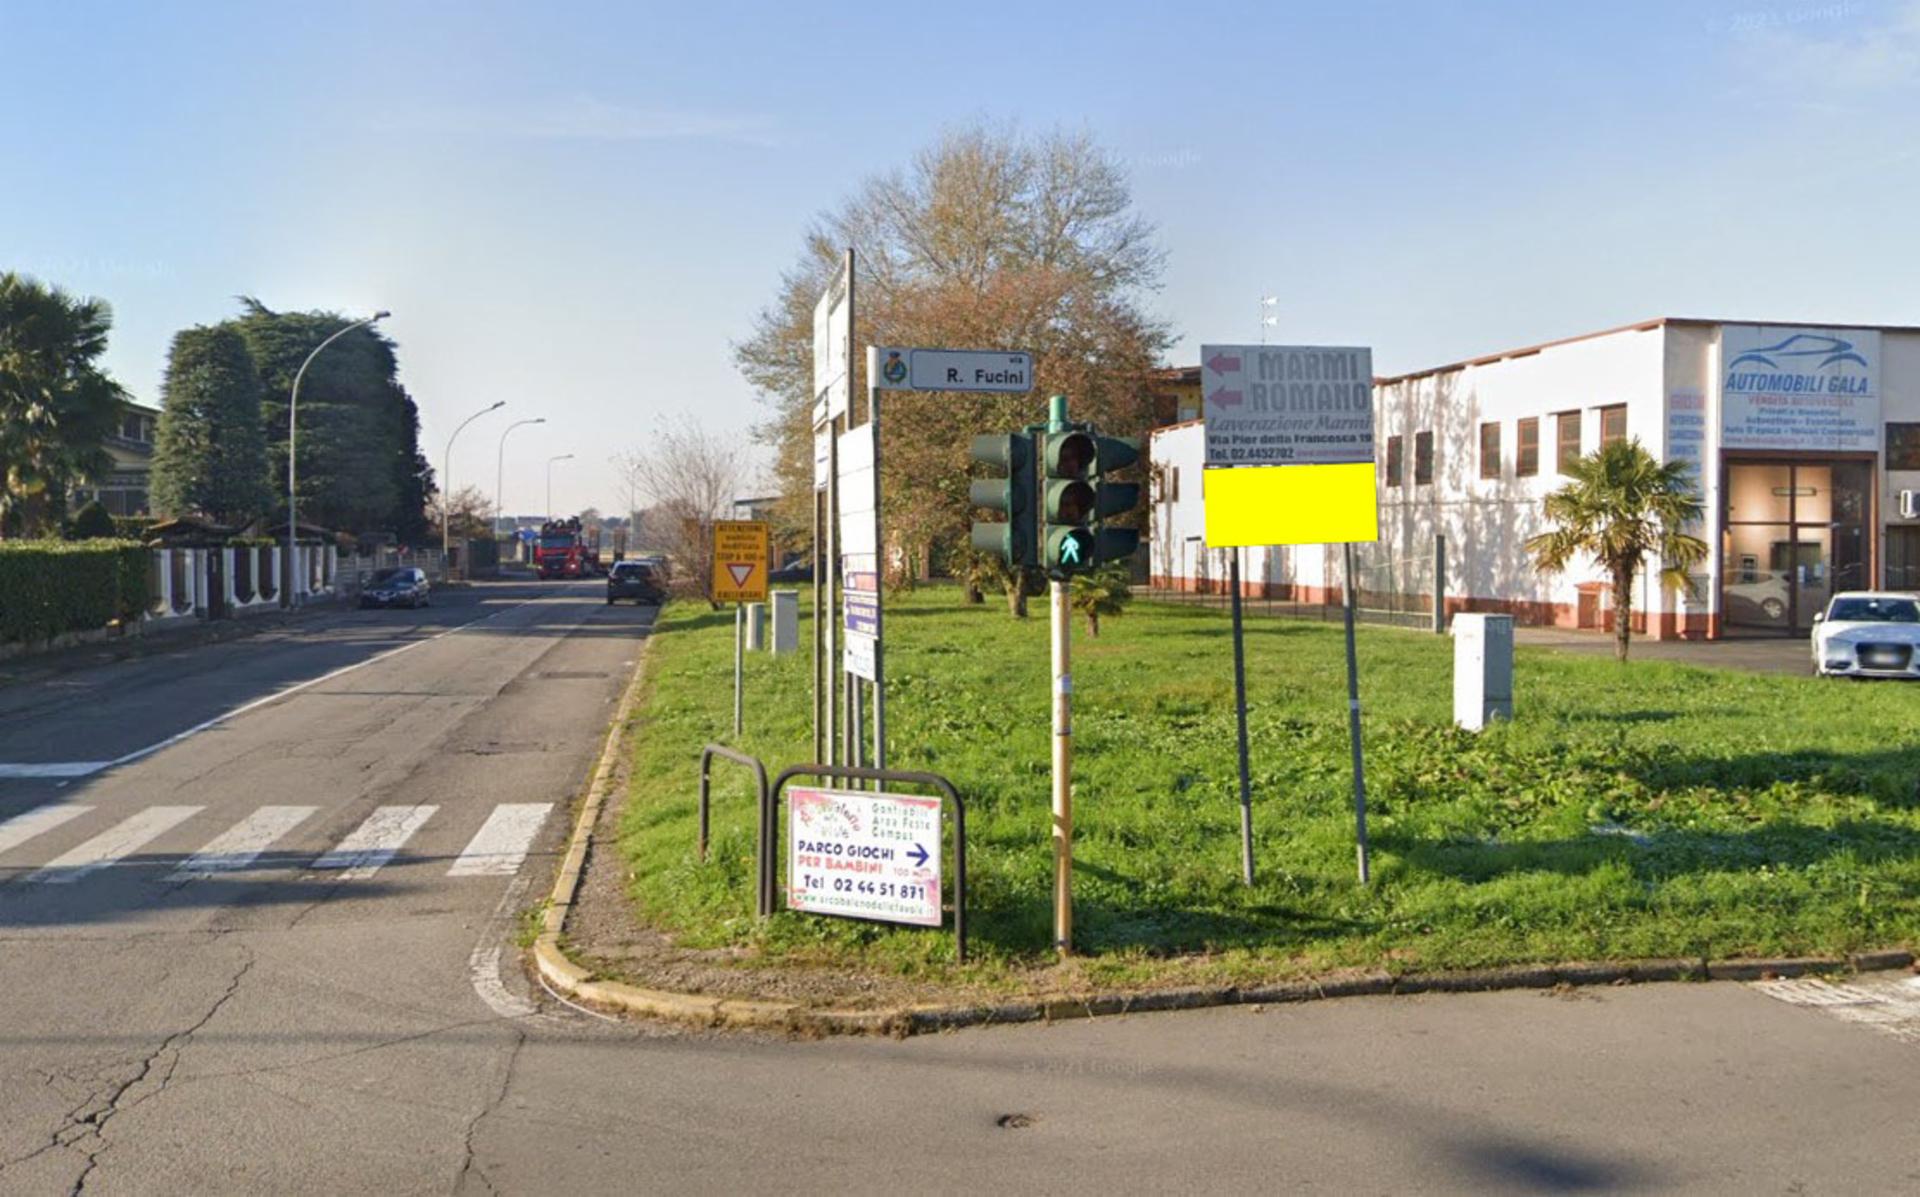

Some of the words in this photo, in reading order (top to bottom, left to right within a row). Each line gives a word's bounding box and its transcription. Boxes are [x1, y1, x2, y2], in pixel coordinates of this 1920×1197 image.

[947, 368, 963, 382] R.
[976, 369, 1023, 384] Fucini
[1258, 352, 1358, 381] MARMI
[1726, 373, 1823, 392] AUTOMOBILI
[1828, 376, 1868, 394] GALA
[1252, 383, 1368, 411] ROMANO
[1209, 416, 1313, 432] Lavorazione
[1314, 415, 1372, 431] Marmi
[1208, 435, 1225, 445] Via
[1232, 435, 1256, 445] Pier
[1294, 434, 1356, 443] Francesca
[798, 840, 844, 856] PARCO
[848, 845, 894, 860] GIOCHI
[798, 855, 821, 867] PER
[826, 858, 883, 874] BAMBINI
[804, 875, 824, 888] Tel
[834, 878, 852, 892] 02
[858, 882, 875, 895] 44
[880, 883, 895, 896] 51
[901, 885, 924, 900] 871
